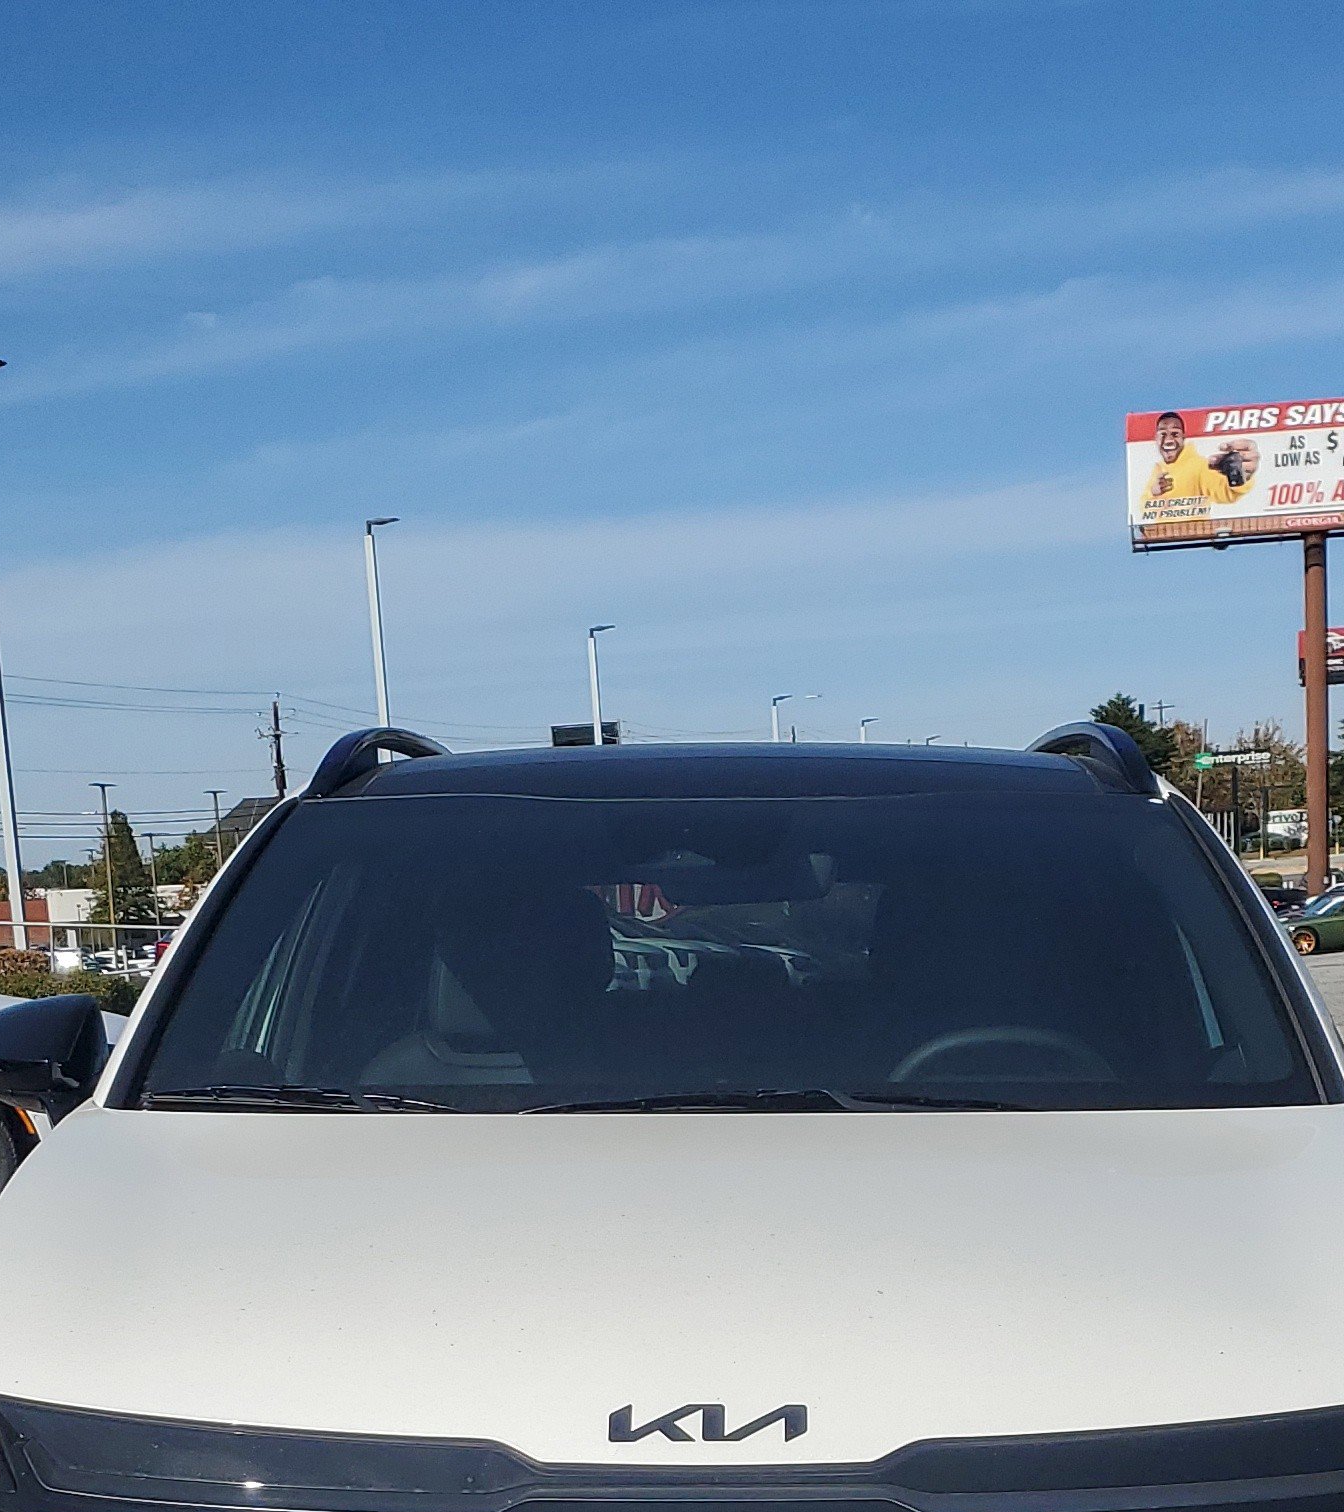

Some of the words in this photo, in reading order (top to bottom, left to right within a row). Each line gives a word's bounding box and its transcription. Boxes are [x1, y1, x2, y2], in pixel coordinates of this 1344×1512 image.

[1205, 407, 1280, 433] PARS
[1290, 436, 1305, 450] AS
[1274, 452, 1303, 467] LOW
[1304, 451, 1320, 466] AS
[1268, 480, 1325, 507] 100%
[1145, 499, 1165, 509] BAD
[1142, 511, 1157, 519] NO
[609, 1404, 807, 1442] KIA
